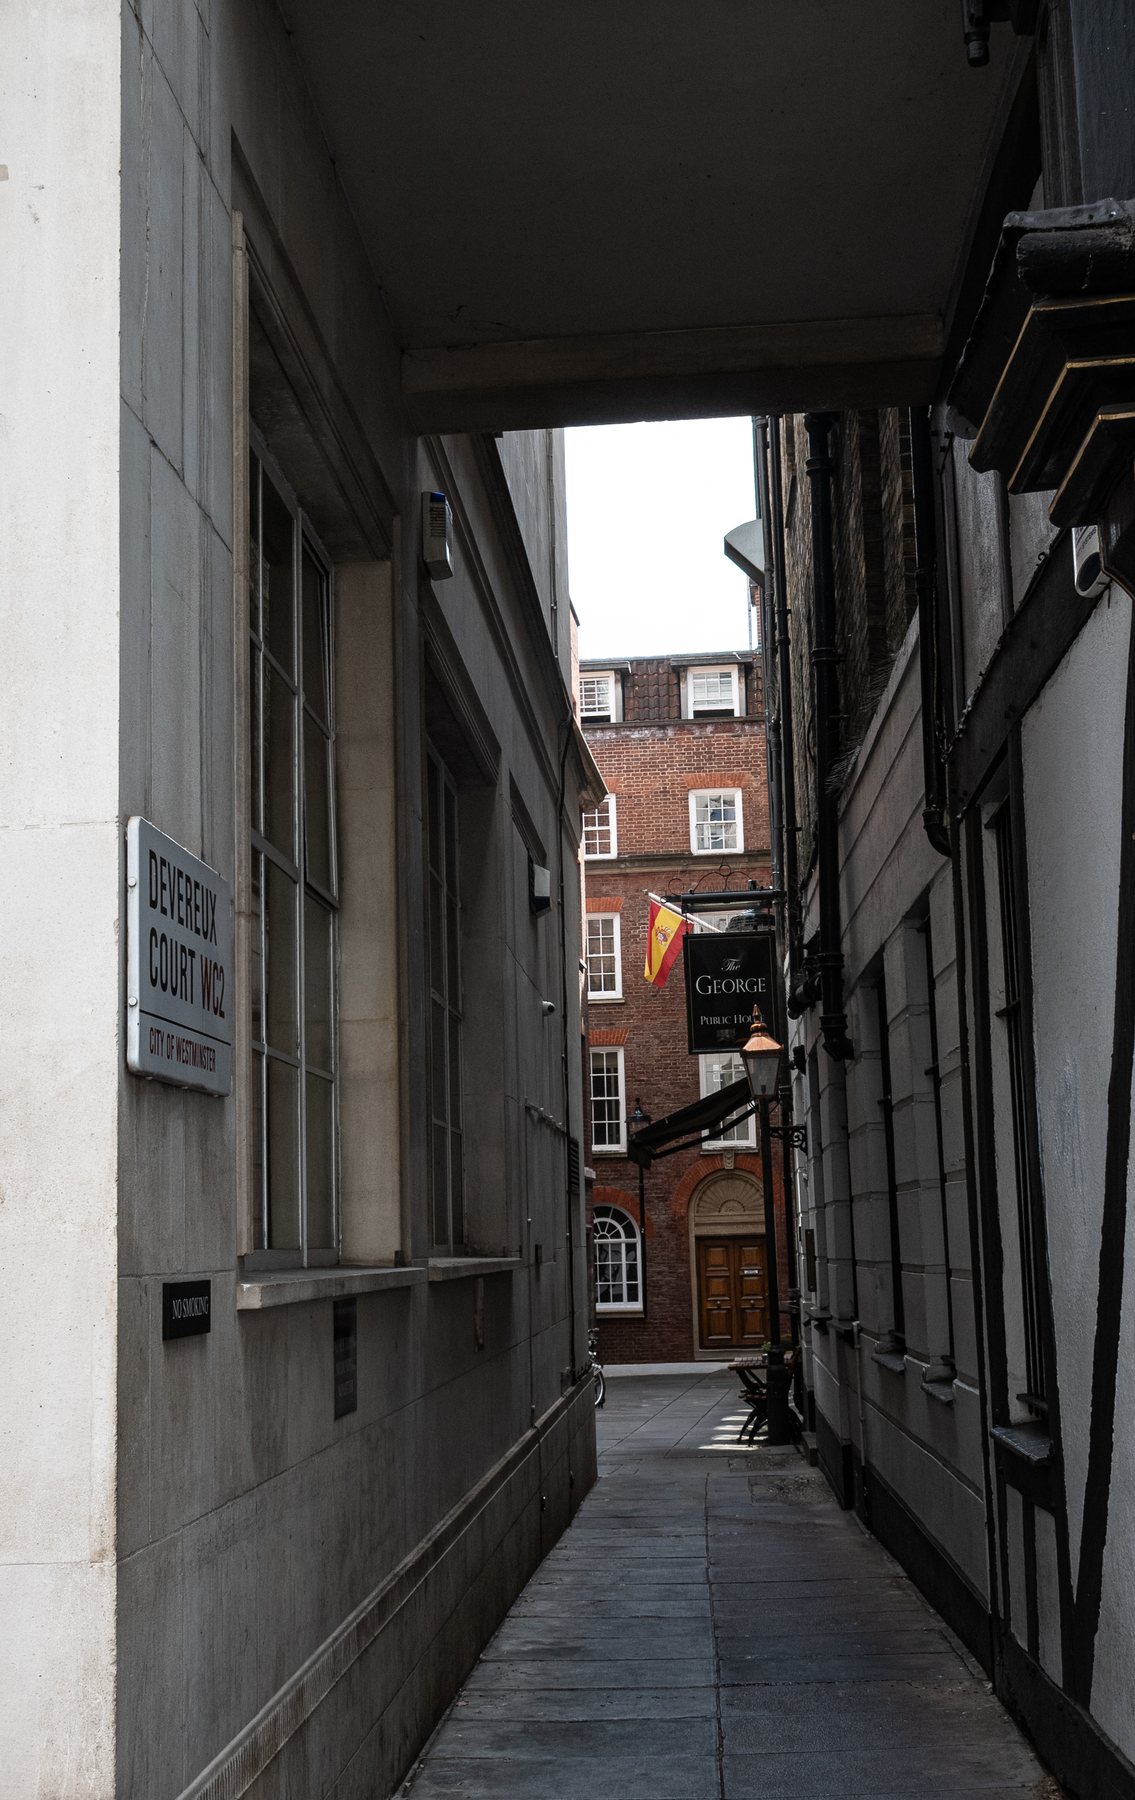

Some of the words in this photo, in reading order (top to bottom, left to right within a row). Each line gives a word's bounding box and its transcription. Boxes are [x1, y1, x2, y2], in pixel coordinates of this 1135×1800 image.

[149, 849, 217, 946] DEVEREUX
[149, 927, 196, 1005] COURT
[200, 954, 225, 1018] WC2
[721, 958, 742, 971] The
[695, 975, 766, 995] GEORGE
[700, 1015, 731, 1025] PUBLIC
[150, 1027, 164, 1056] CITY
[167, 1033, 174, 1060] OF
[176, 1036, 216, 1072] WESTMINSTER
[172, 1299, 182, 1320] NO
[182, 1296, 208, 1317] SMOKING
